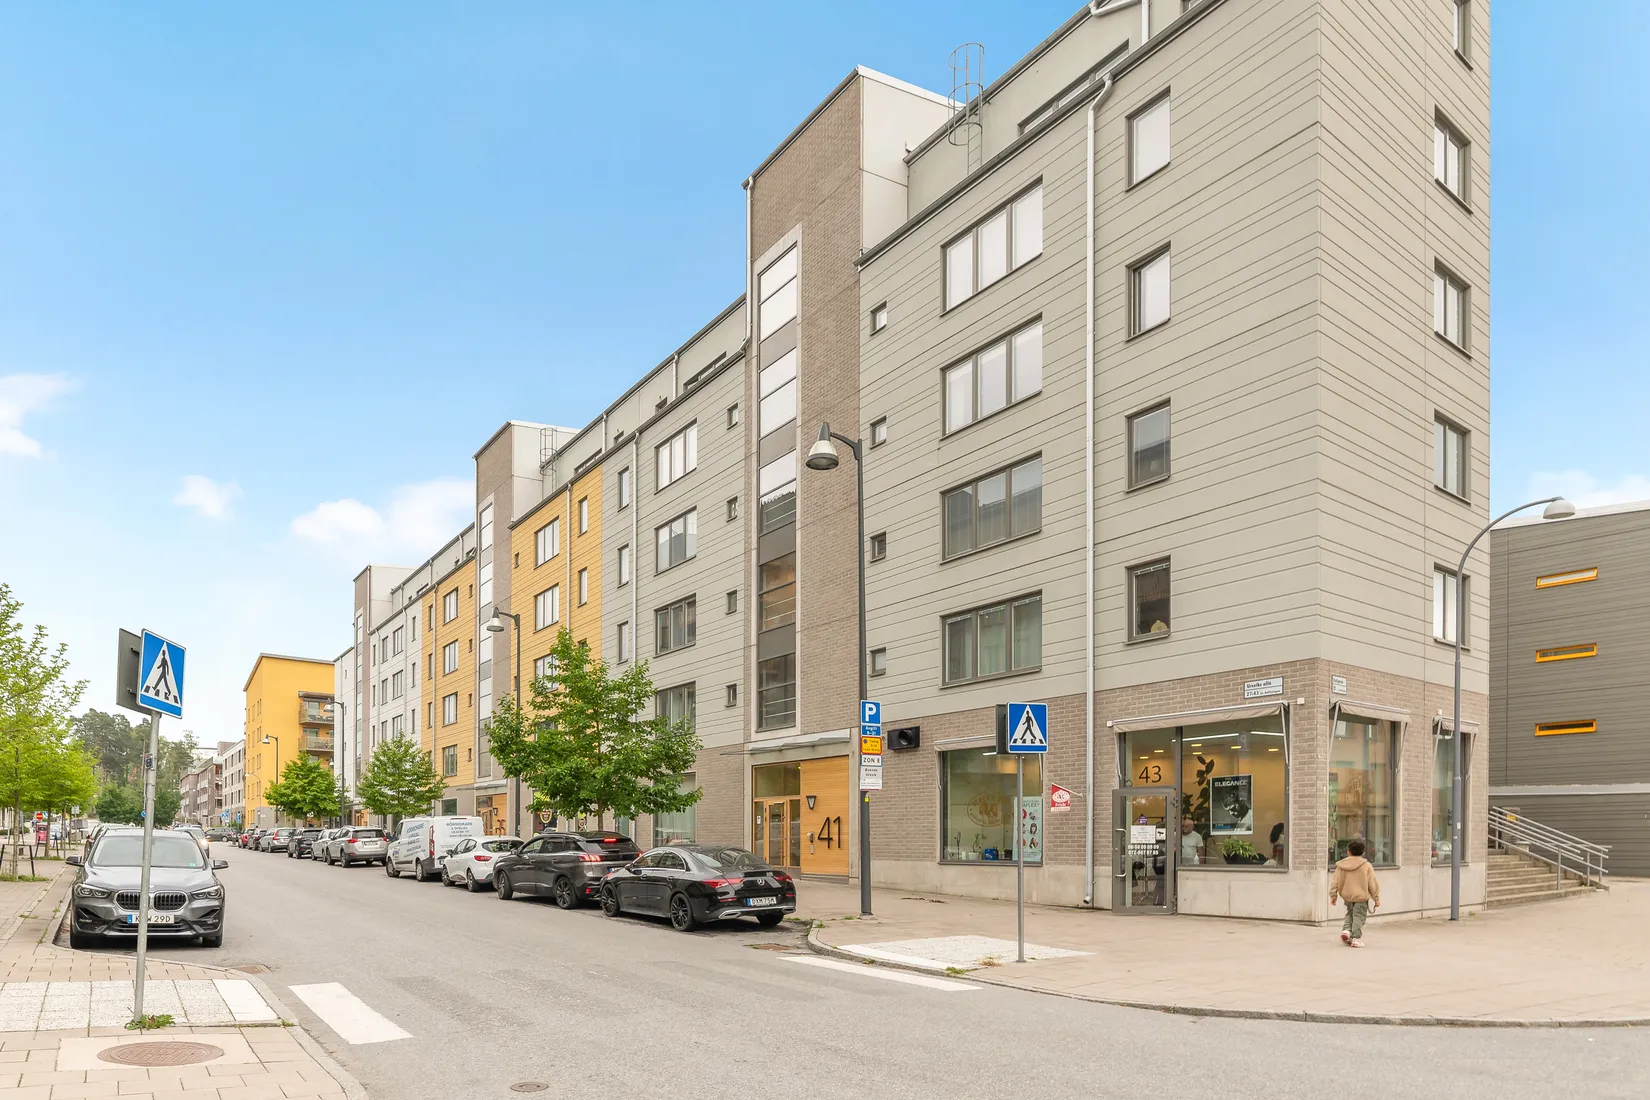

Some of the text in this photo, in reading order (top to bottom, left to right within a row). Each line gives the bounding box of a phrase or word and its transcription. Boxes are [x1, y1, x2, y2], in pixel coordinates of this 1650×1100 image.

[865, 703, 877, 722] P
[1138, 765, 1162, 783] 43
[817, 816, 841, 849] 41
[154, 915, 171, 923] 29D
